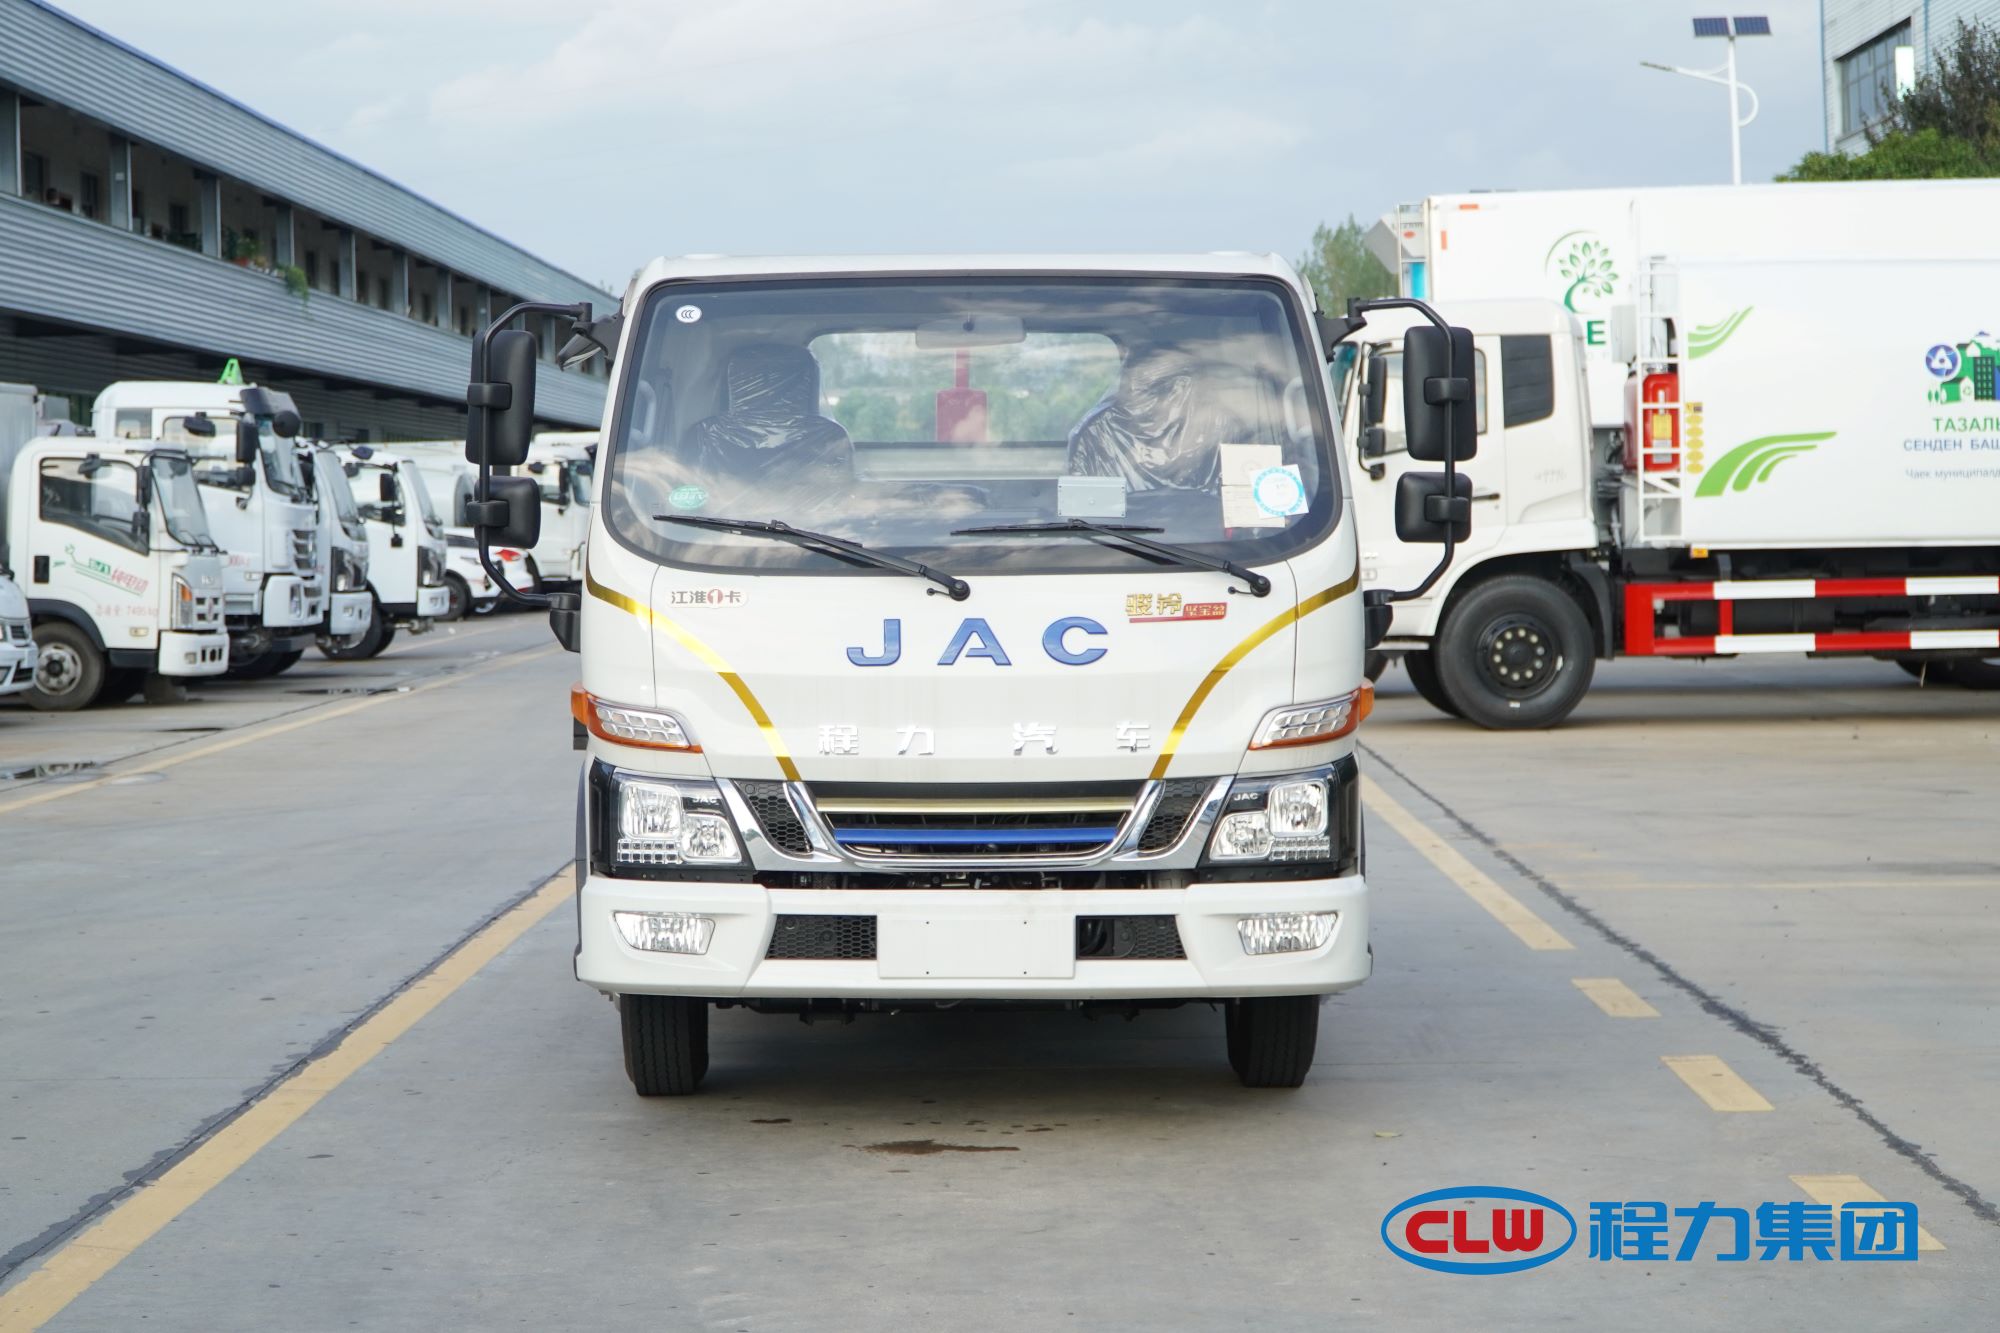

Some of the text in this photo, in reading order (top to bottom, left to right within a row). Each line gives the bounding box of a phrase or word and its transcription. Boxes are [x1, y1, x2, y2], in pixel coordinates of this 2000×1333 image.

[1903, 438, 1963, 453] СЕНДЕН
[846, 616, 1109, 667] JAC
[1233, 792, 1259, 801] JAC
